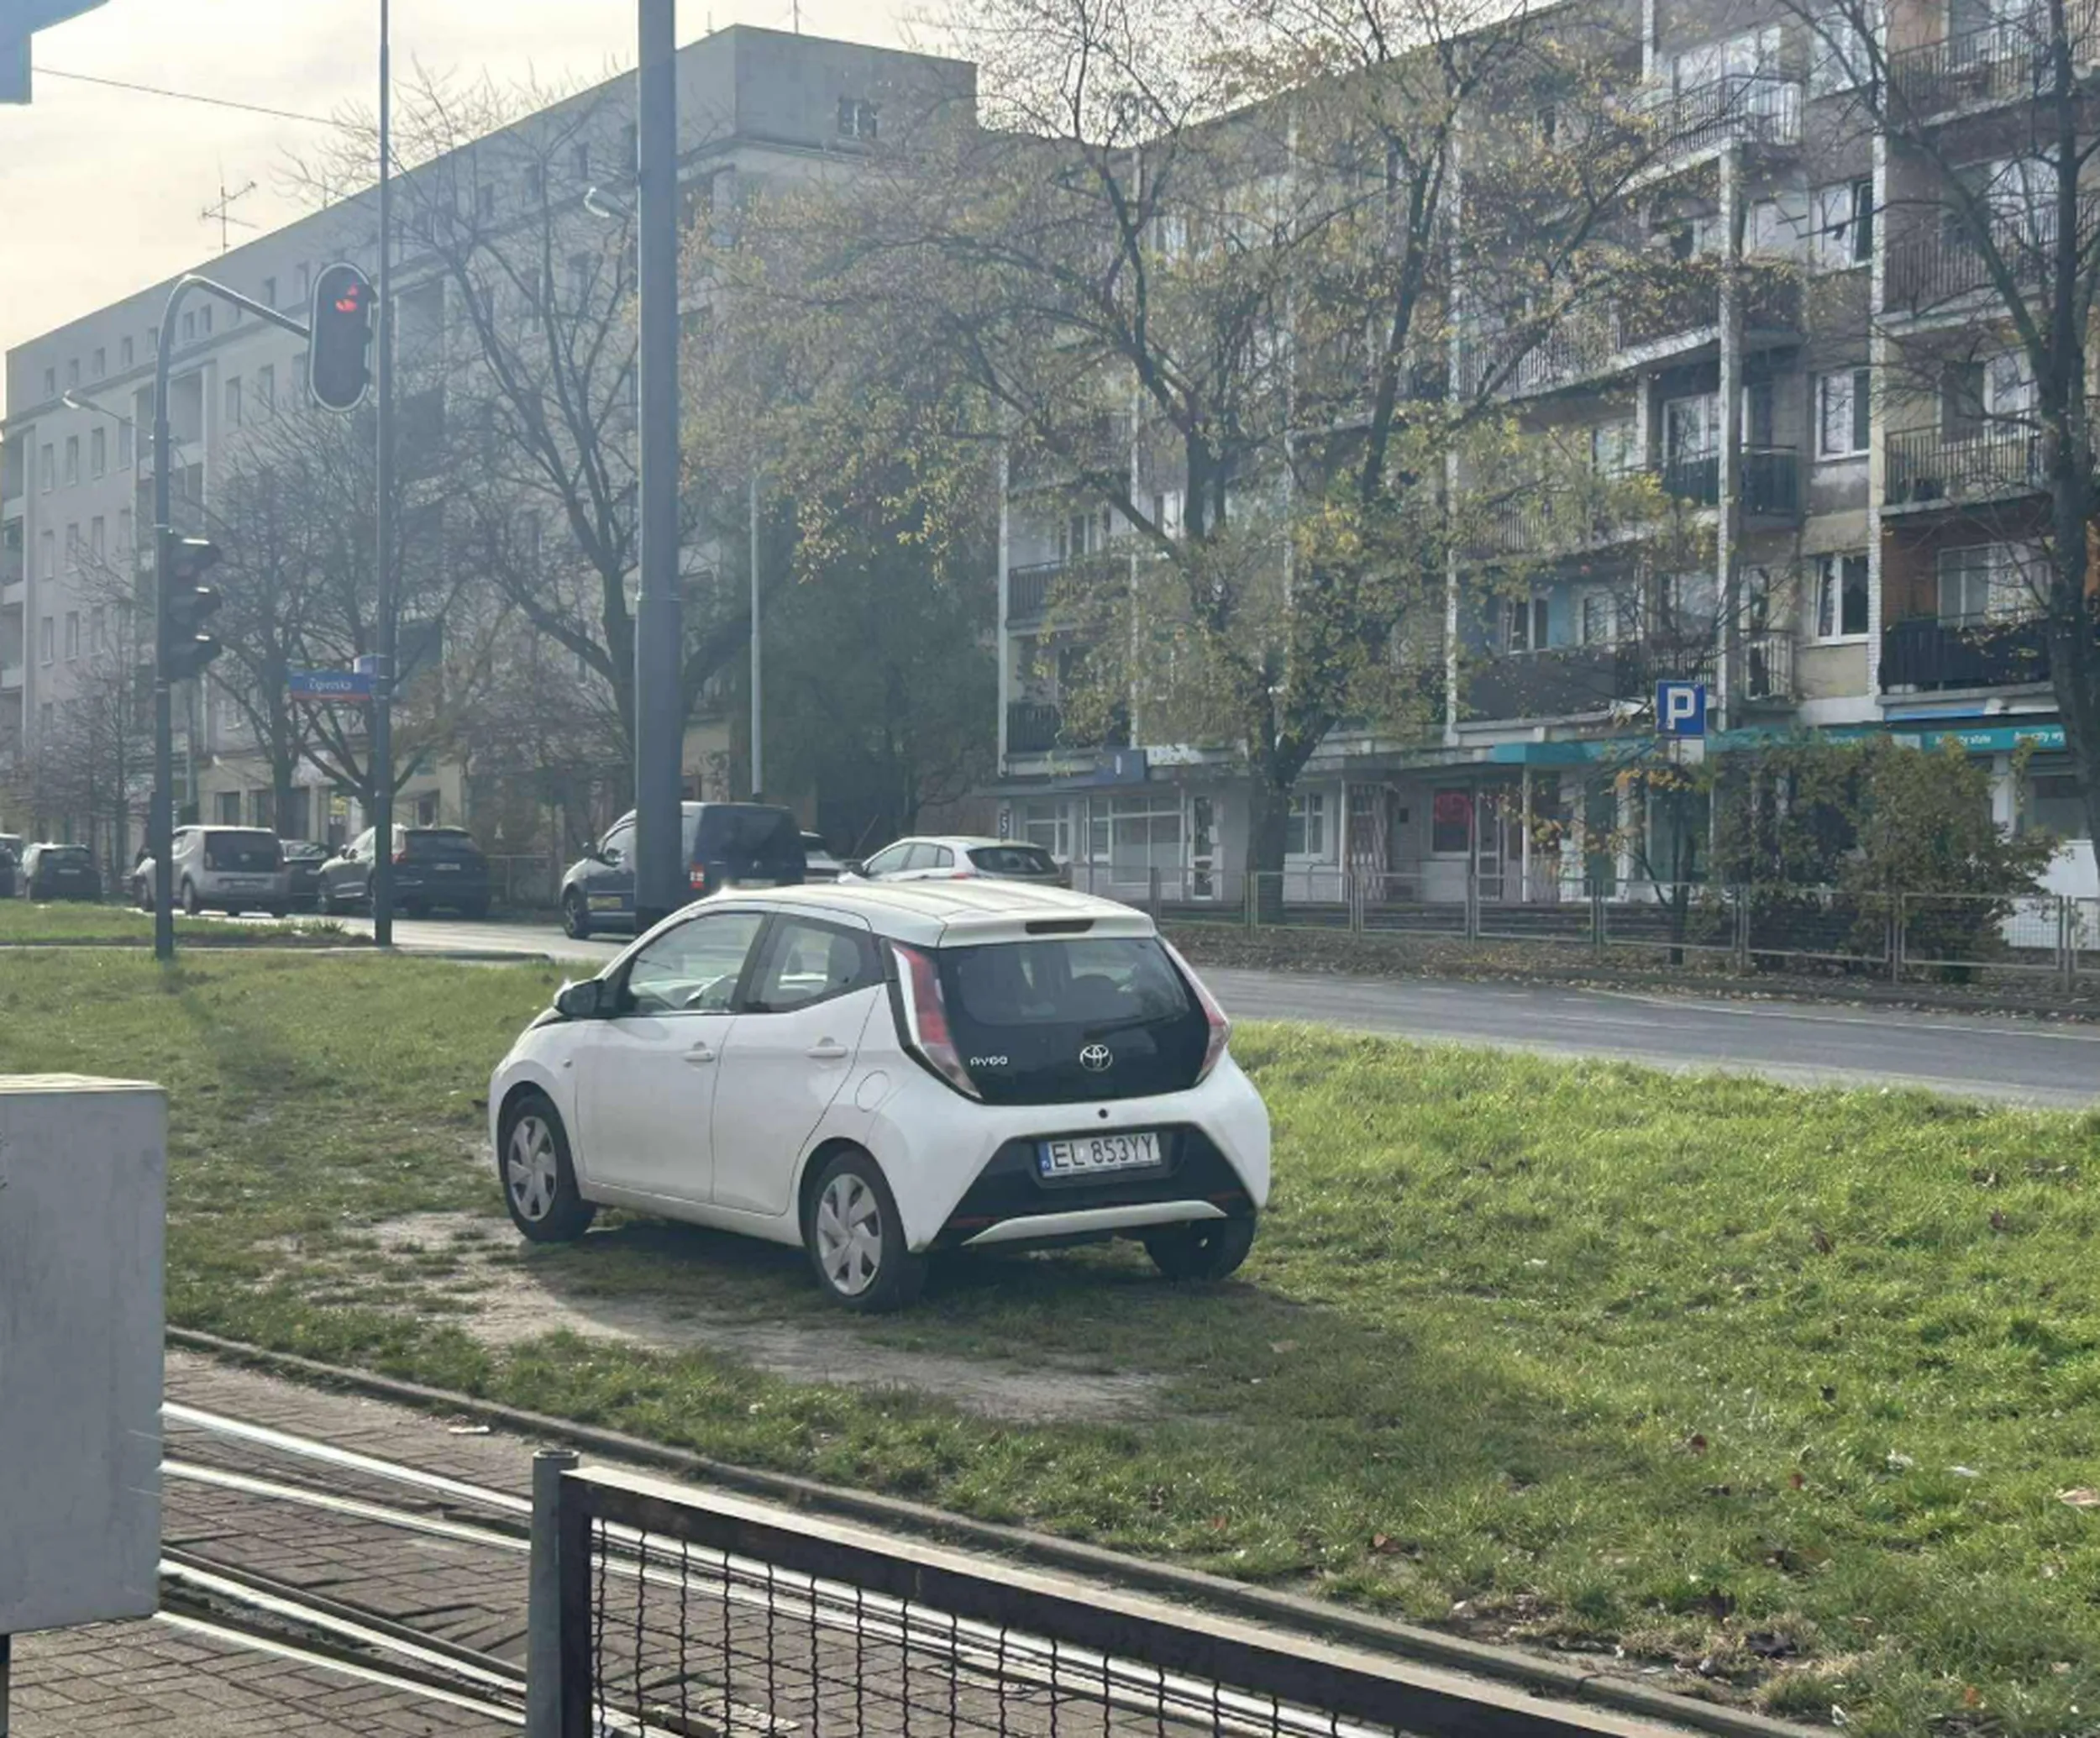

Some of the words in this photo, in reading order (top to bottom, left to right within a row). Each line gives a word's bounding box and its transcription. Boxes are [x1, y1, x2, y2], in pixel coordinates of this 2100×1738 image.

[1667, 687, 1695, 730] P
[1051, 1142, 1085, 1168] EL
[1090, 1135, 1154, 1164] 853YY
